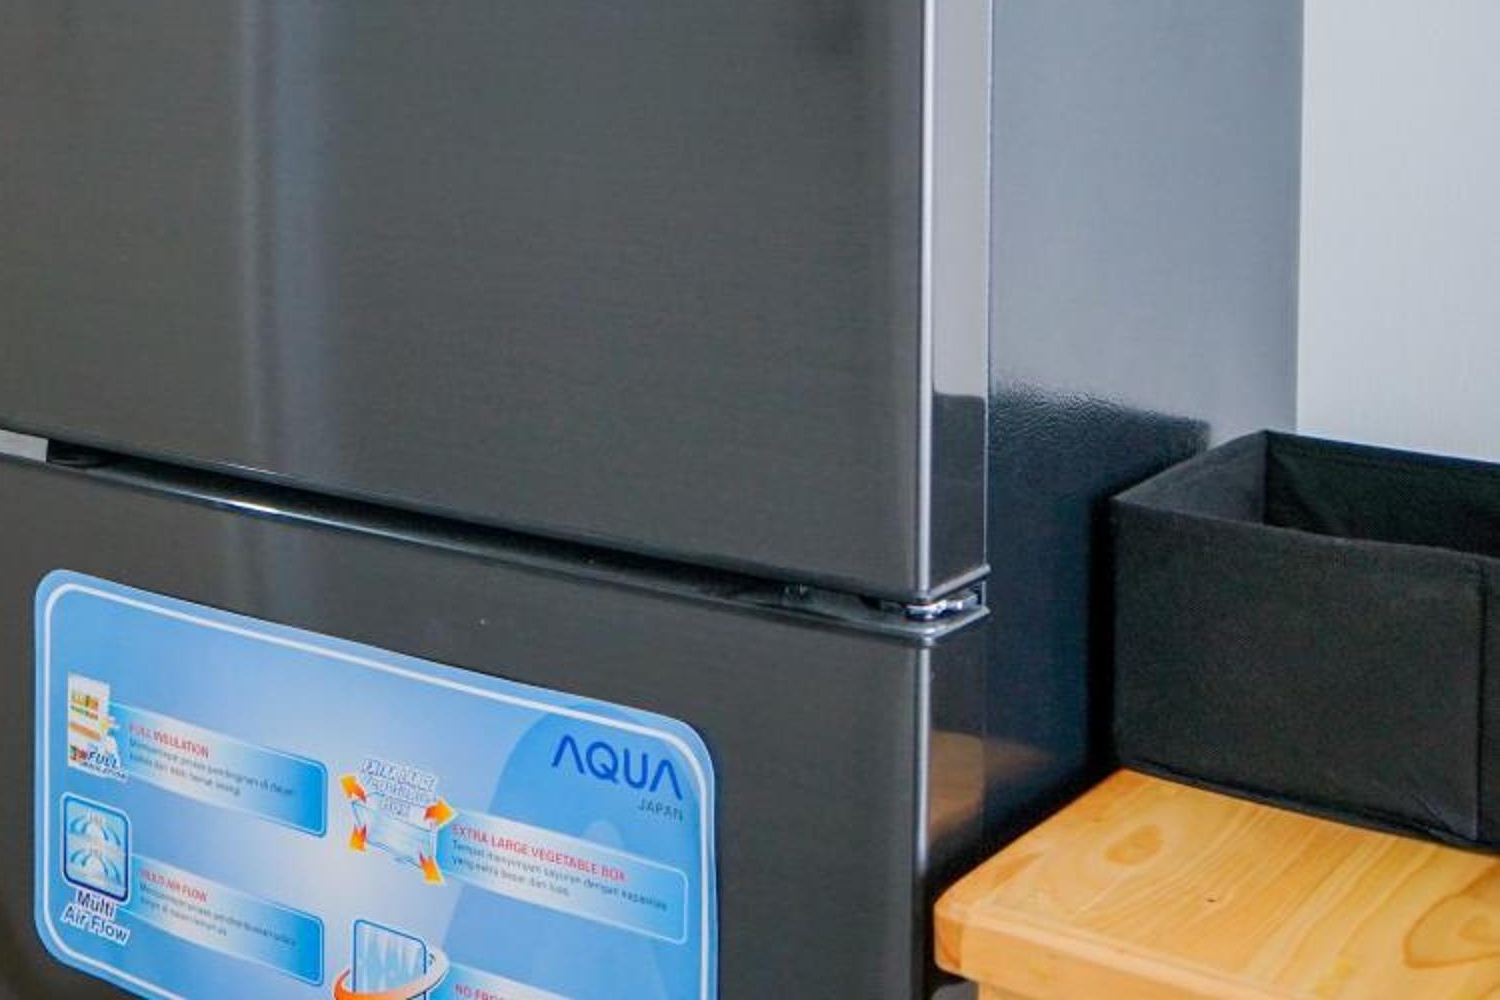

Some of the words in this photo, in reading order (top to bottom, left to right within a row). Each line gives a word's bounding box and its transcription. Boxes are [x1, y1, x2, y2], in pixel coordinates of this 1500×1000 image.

[153, 729, 210, 759] INSULATION
[87, 750, 118, 769] FULL
[552, 734, 683, 801] AQUA
[638, 798, 685, 823] JAPAN
[452, 825, 488, 845] EXTRA
[490, 833, 528, 856] LARGE
[531, 845, 598, 876] VEGETABLE
[601, 863, 626, 882] BOX
[77, 889, 115, 918] Multi
[180, 879, 208, 902] FLOW
[64, 906, 88, 928] Air
[89, 913, 128, 941] Flow
[455, 983, 474, 999] NO
